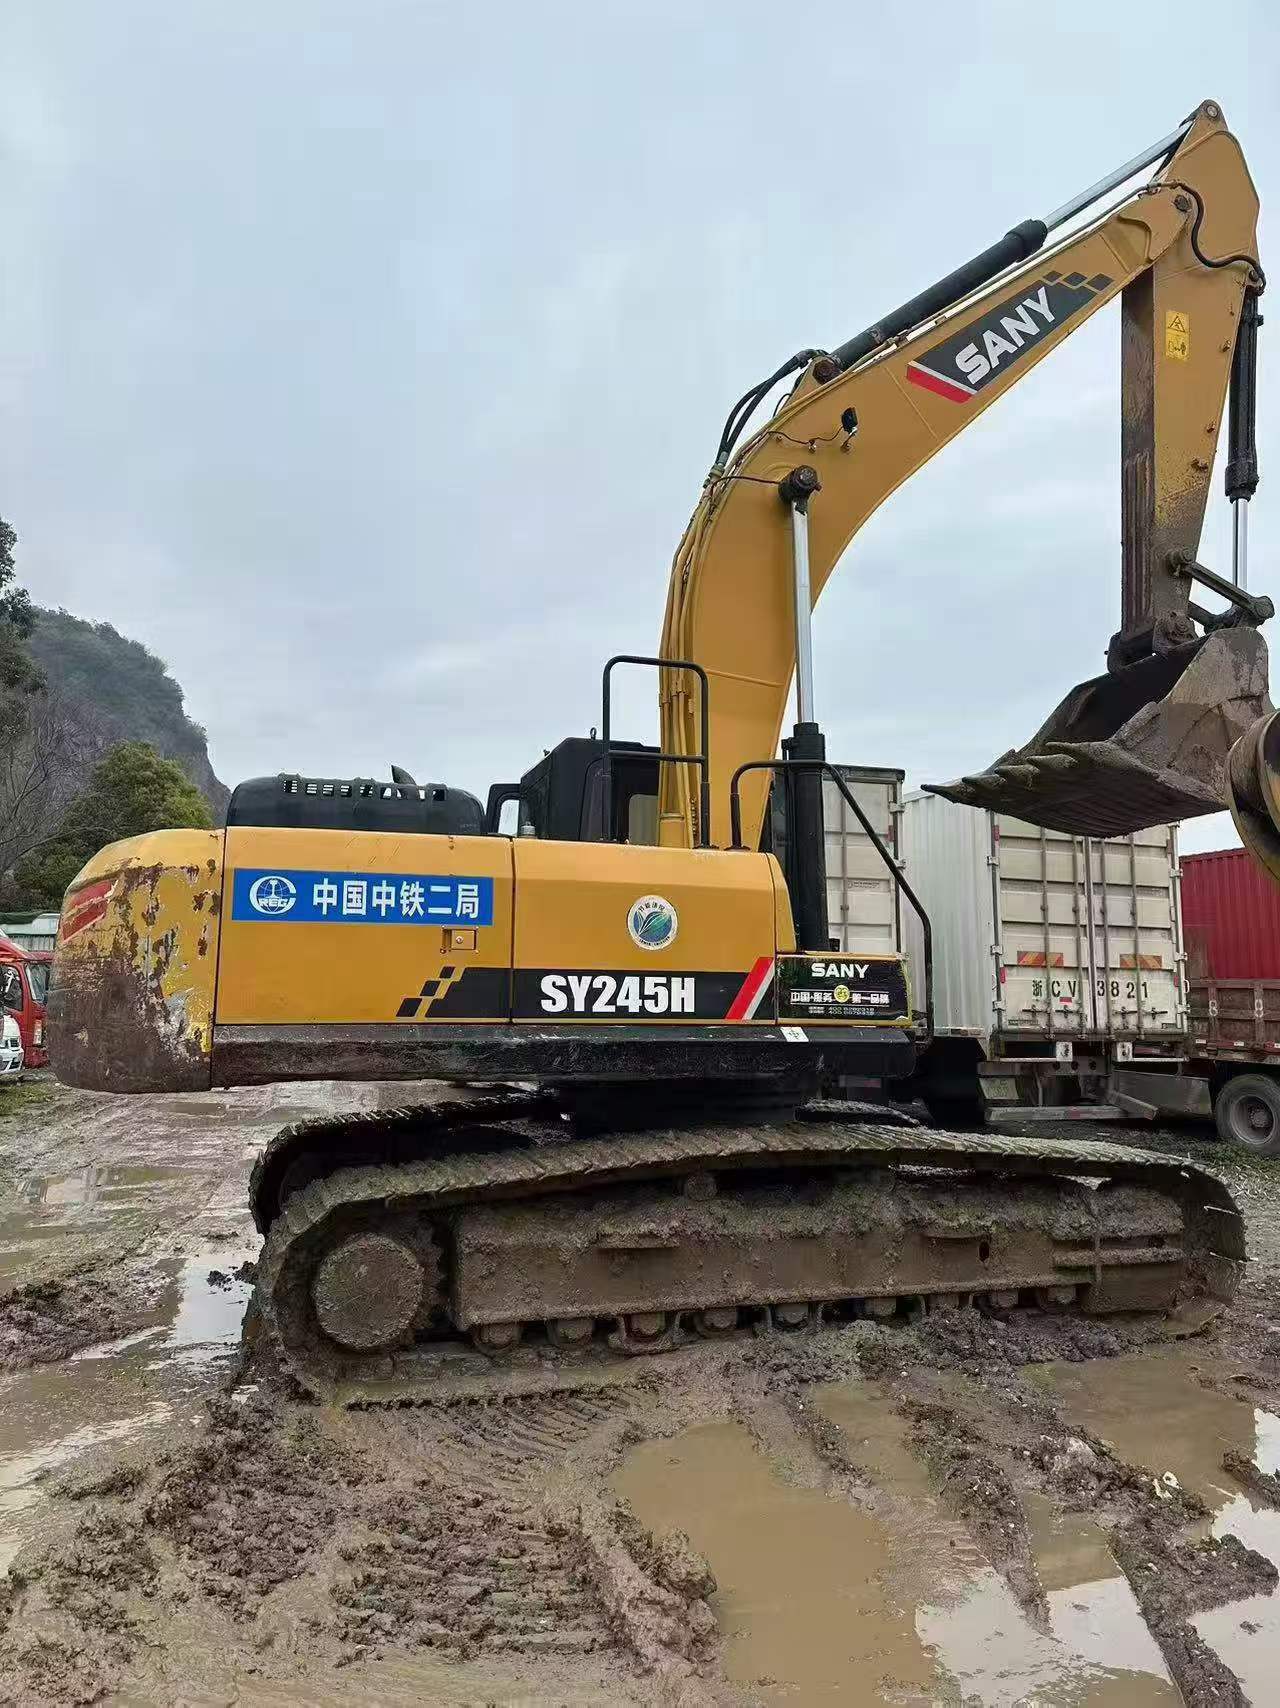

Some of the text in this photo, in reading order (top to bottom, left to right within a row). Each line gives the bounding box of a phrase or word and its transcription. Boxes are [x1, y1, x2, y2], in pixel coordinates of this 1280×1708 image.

[956, 286, 1055, 385] SANY
[312, 878, 479, 919] 中国中铁二局
[811, 962, 869, 979] SANY
[540, 975, 695, 1013] SY245H
